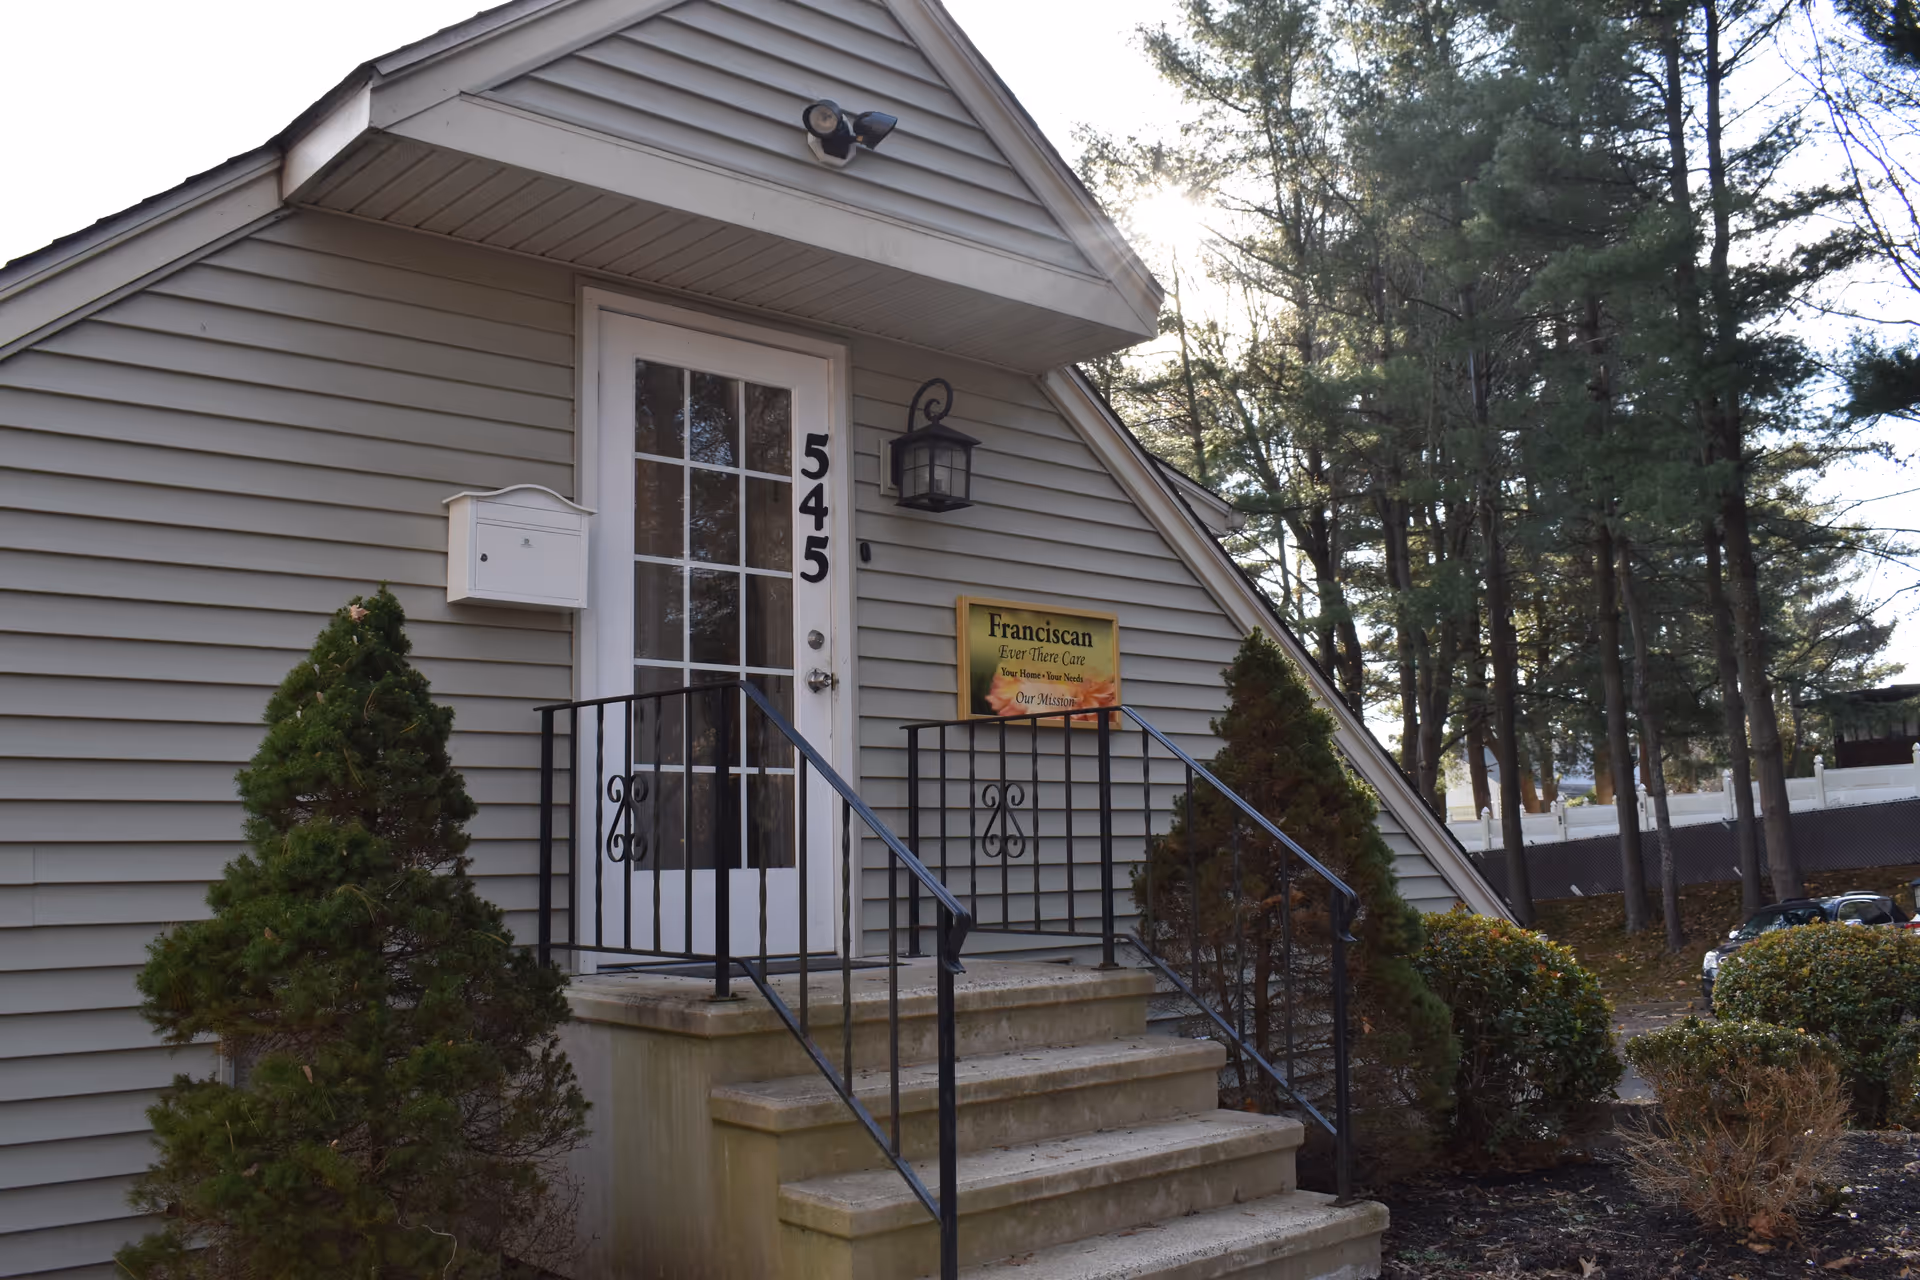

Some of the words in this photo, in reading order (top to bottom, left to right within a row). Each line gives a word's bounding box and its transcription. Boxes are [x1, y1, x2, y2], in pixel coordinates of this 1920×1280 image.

[799, 433, 829, 583] 545
[988, 612, 1093, 648] Franciscan
[998, 645, 1027, 660] Ever
[1029, 646, 1059, 663] There
[1062, 651, 1086, 666] Care
[1001, 667, 1018, 677] Your
[1019, 668, 1041, 680] Home
[1046, 671, 1062, 681] Your
[1063, 673, 1084, 683] Needs
[1015, 691, 1036, 705] Our
[1037, 693, 1076, 707] Mission
